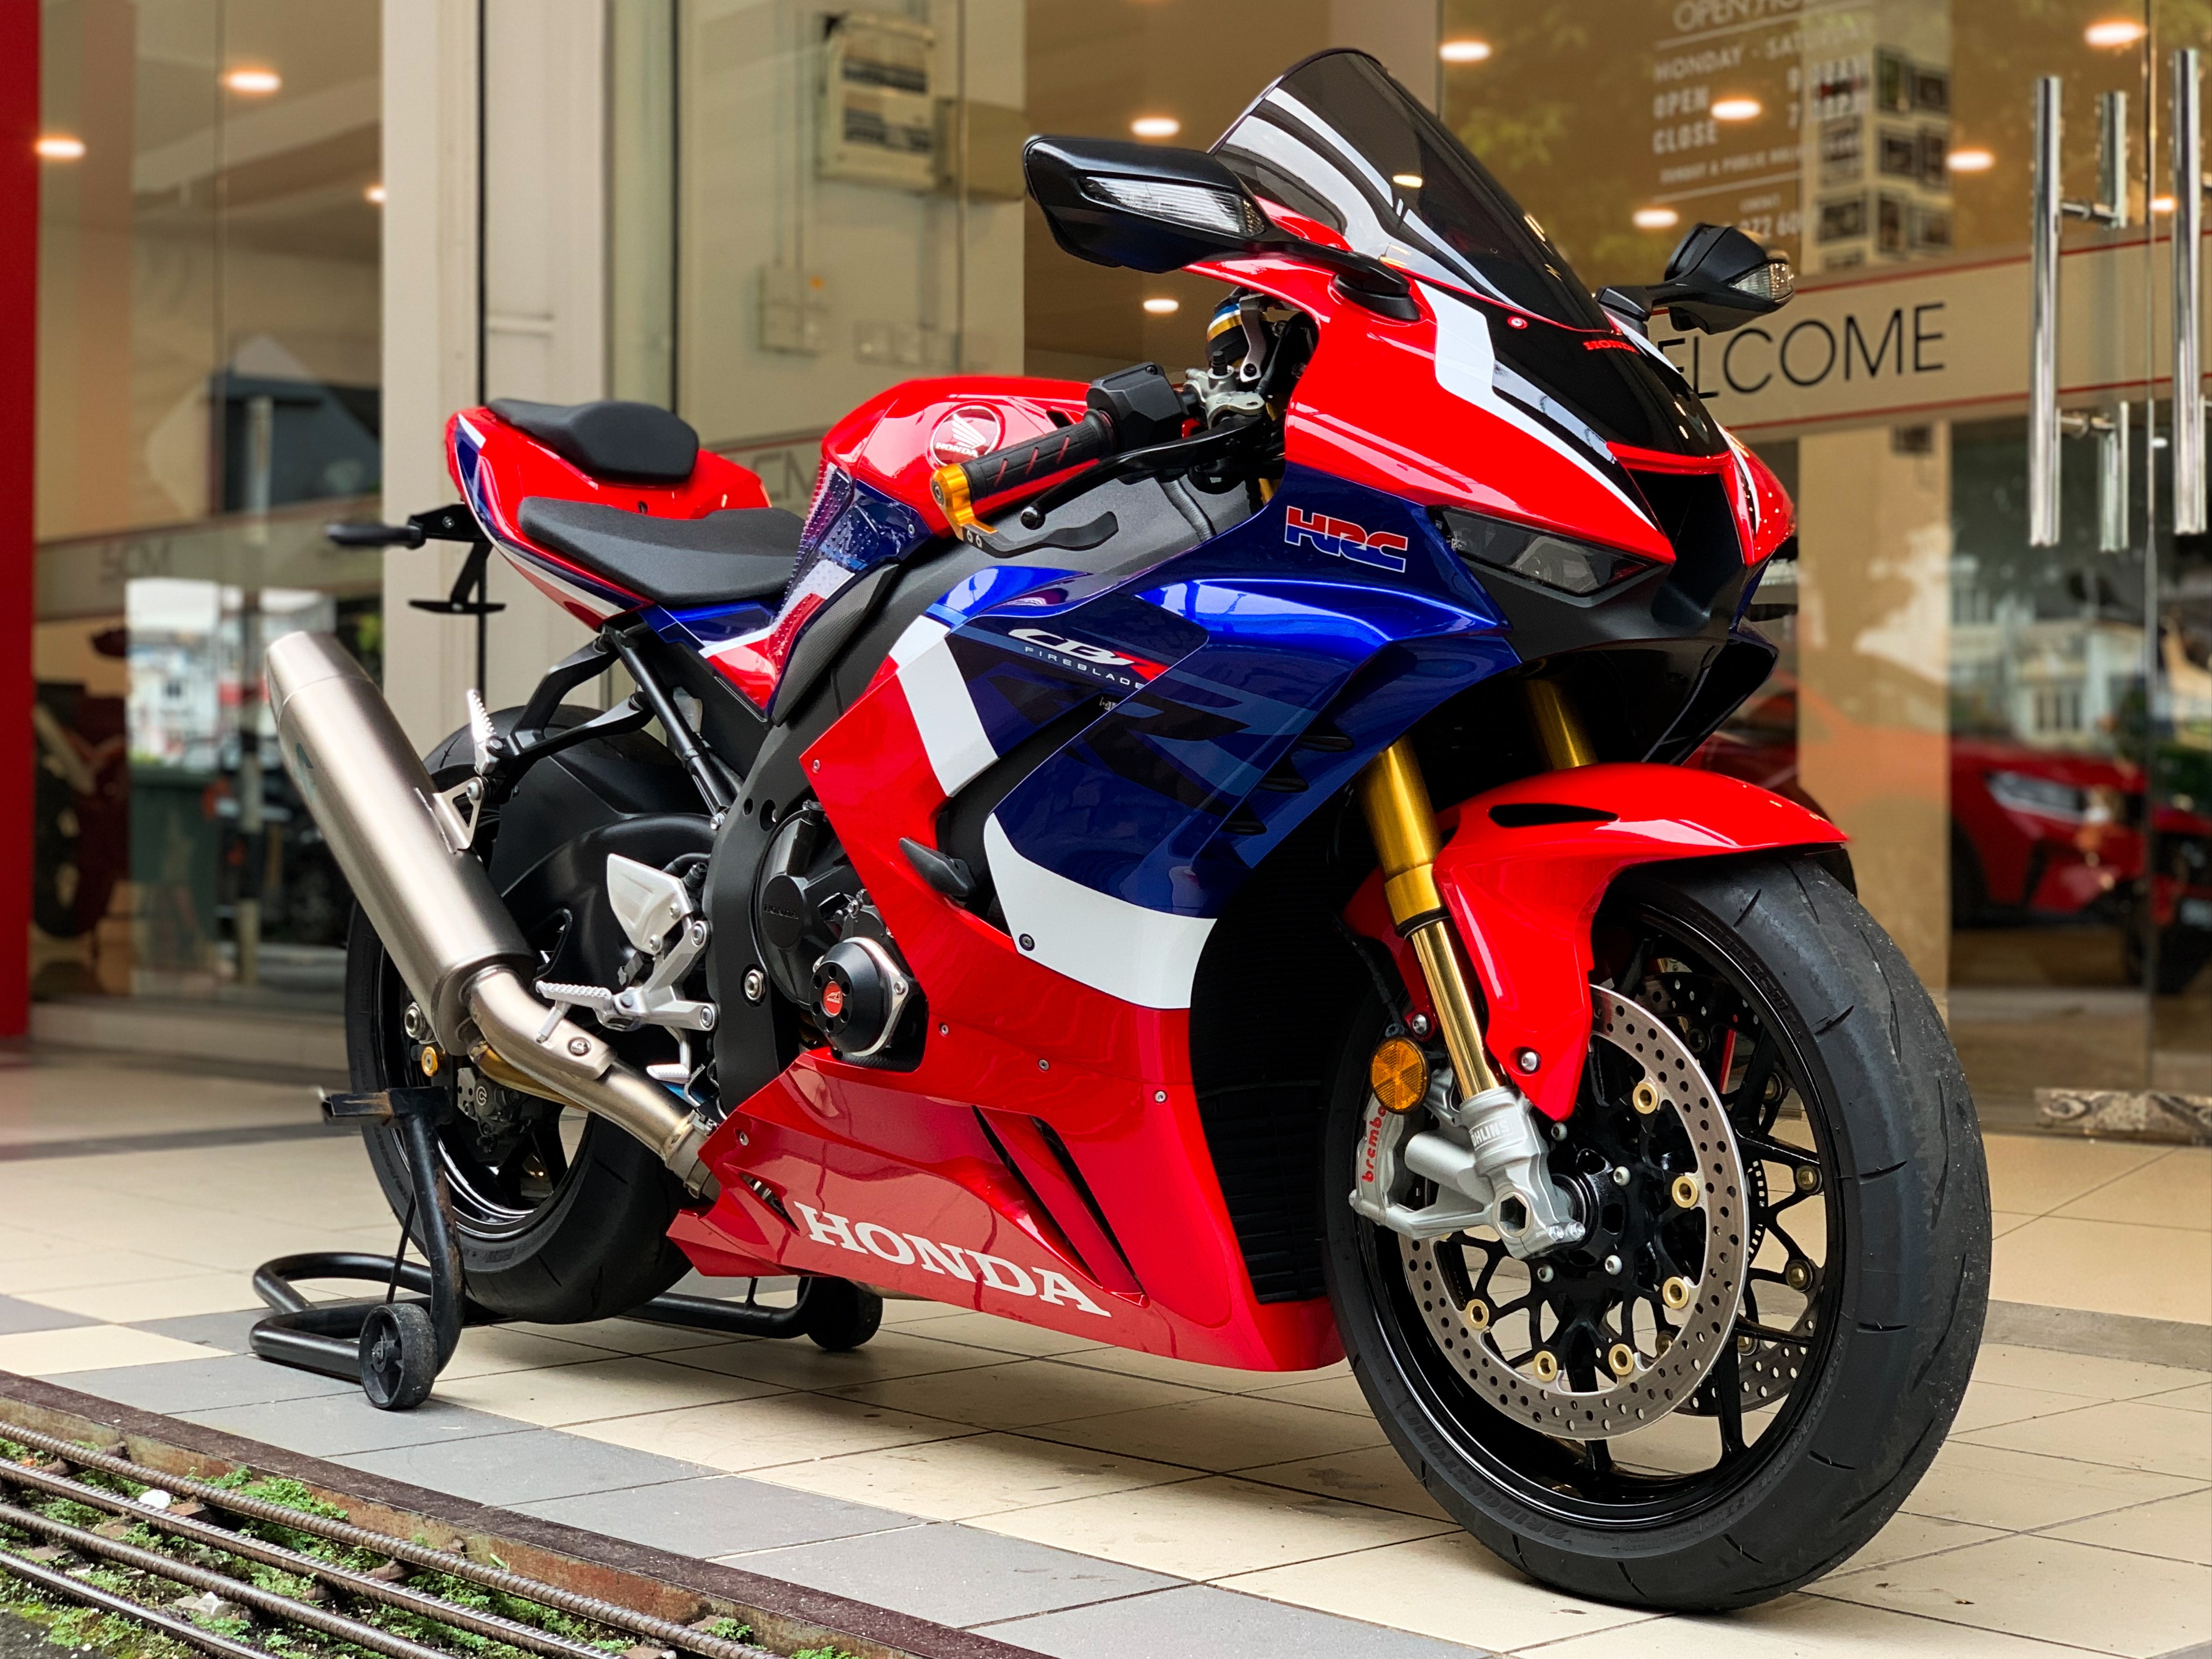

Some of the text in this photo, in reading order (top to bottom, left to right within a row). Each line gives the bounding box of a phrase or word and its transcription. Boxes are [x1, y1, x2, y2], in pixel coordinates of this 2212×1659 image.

[1652, 119, 1717, 155] CLOSE
[1658, 303, 1945, 399] LCOME
[935, 442, 979, 458] HONDA
[1285, 506, 1408, 572] HRC
[1025, 647, 1145, 689] FIREBLADE
[762, 903, 799, 920] HONDA
[1361, 1105, 1387, 1182] brembo
[794, 1201, 1112, 1317] HONDA
